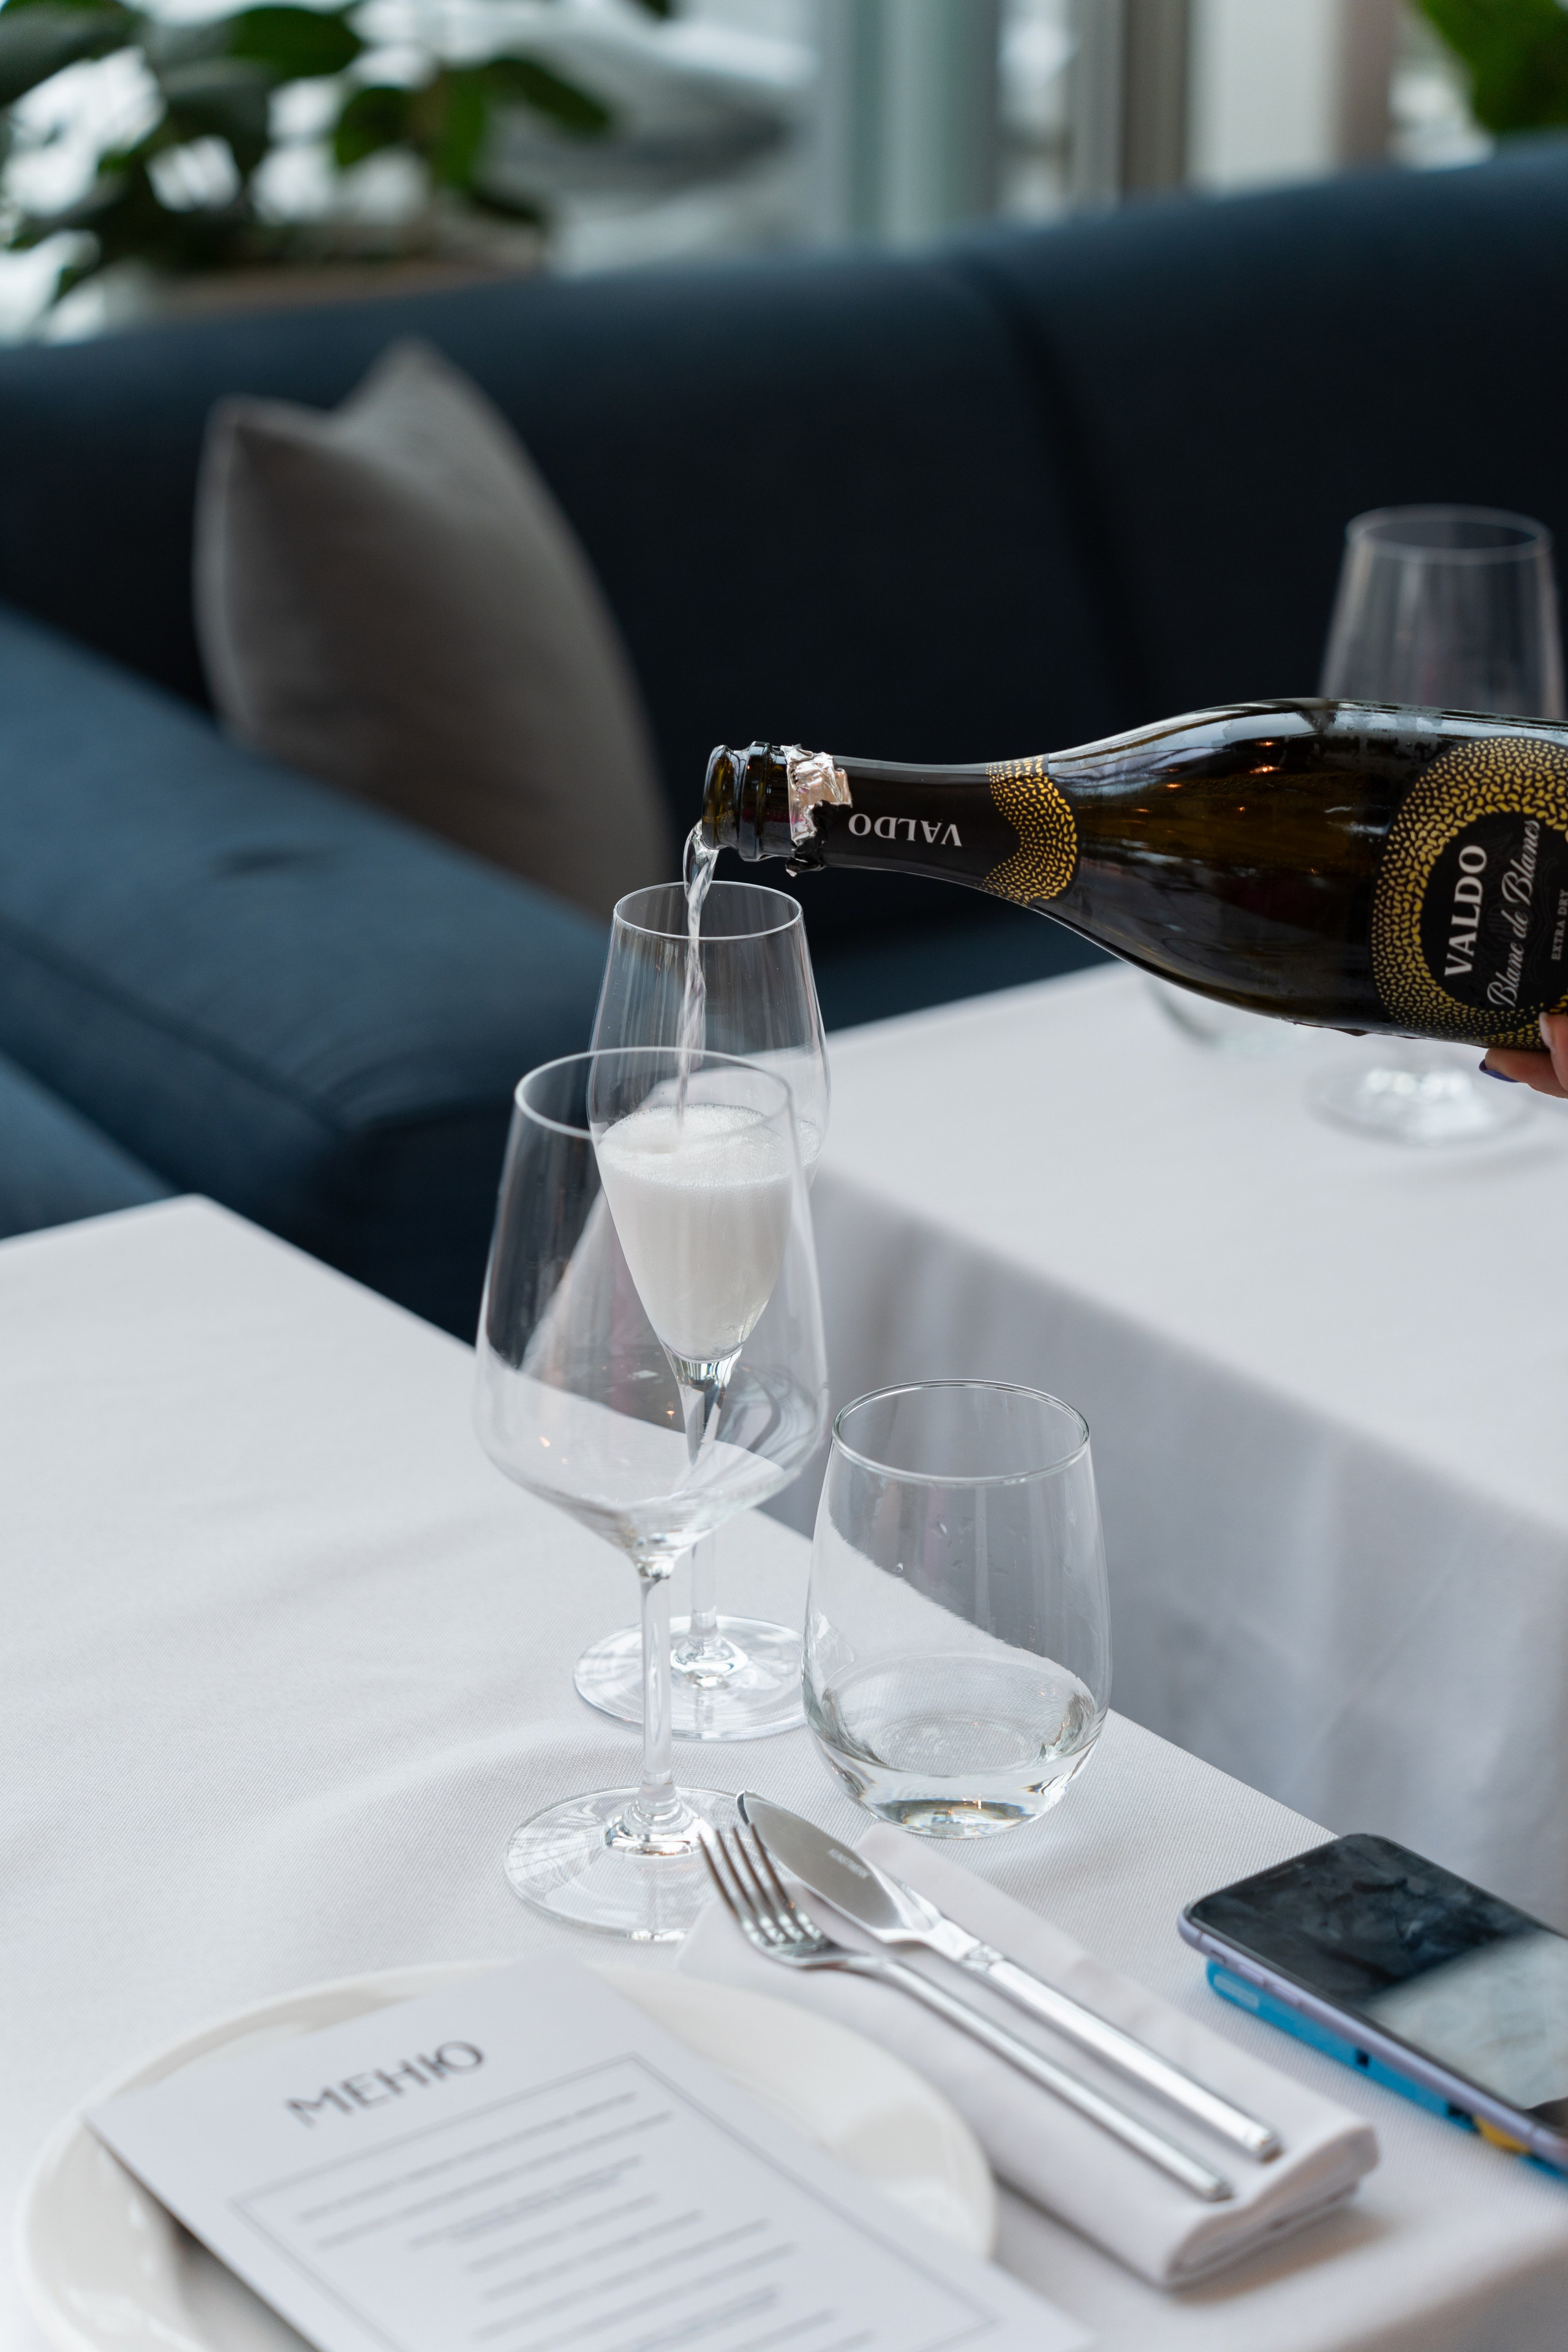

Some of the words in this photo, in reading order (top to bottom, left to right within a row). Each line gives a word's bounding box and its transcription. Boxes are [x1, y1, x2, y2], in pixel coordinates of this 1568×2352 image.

[848, 813, 963, 847] VALDO
[1501, 820, 1541, 906] Blancs
[1444, 845, 1487, 976] VALDO
[1501, 908, 1529, 939] de
[1557, 889, 1568, 916] DRY
[1551, 921, 1566, 961] EXTRA
[1487, 941, 1524, 1007] Blanc
[284, 2040, 486, 2128] МЕНЮ
